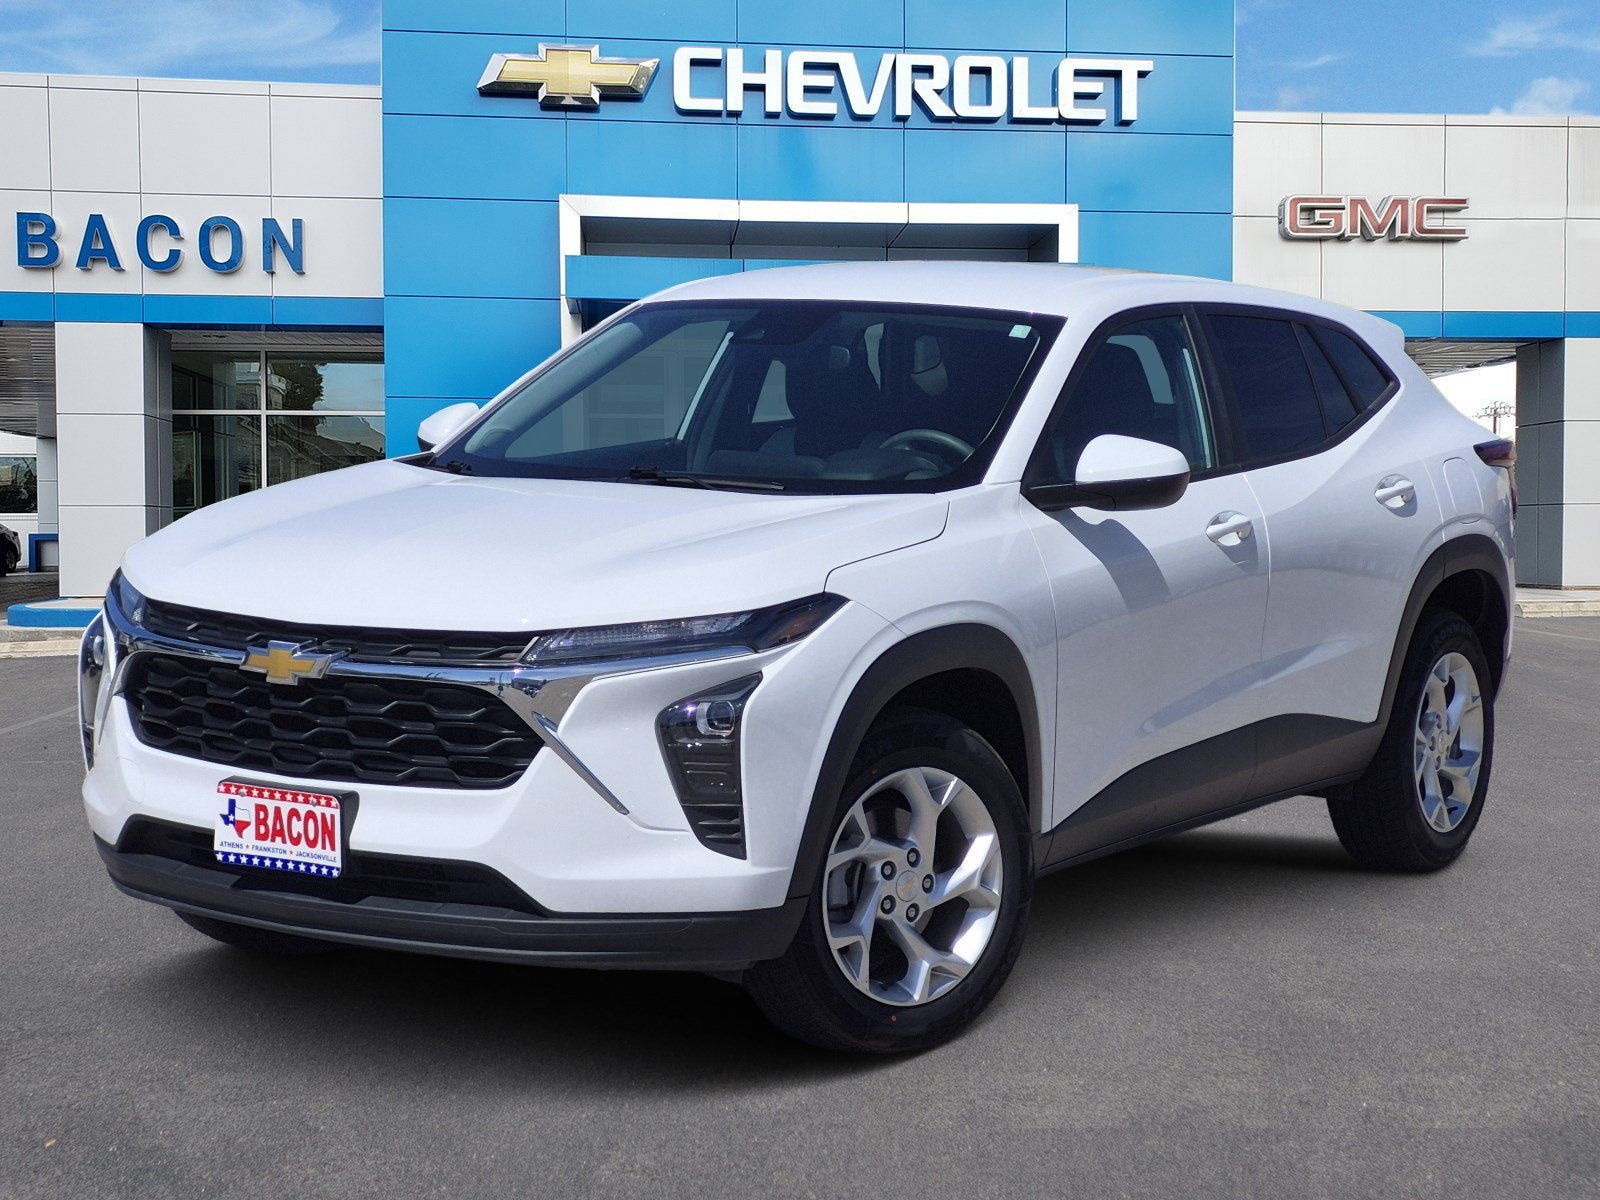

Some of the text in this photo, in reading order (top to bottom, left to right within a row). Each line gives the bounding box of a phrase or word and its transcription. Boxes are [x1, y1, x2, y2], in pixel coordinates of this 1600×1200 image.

[673, 46, 1154, 125] CHEVROLET
[1279, 195, 1469, 241] GMC
[16, 211, 306, 275] BACON
[219, 840, 337, 863] ATHENS FRANKSTON JACKSONVILLE
[255, 803, 336, 852] BACON
